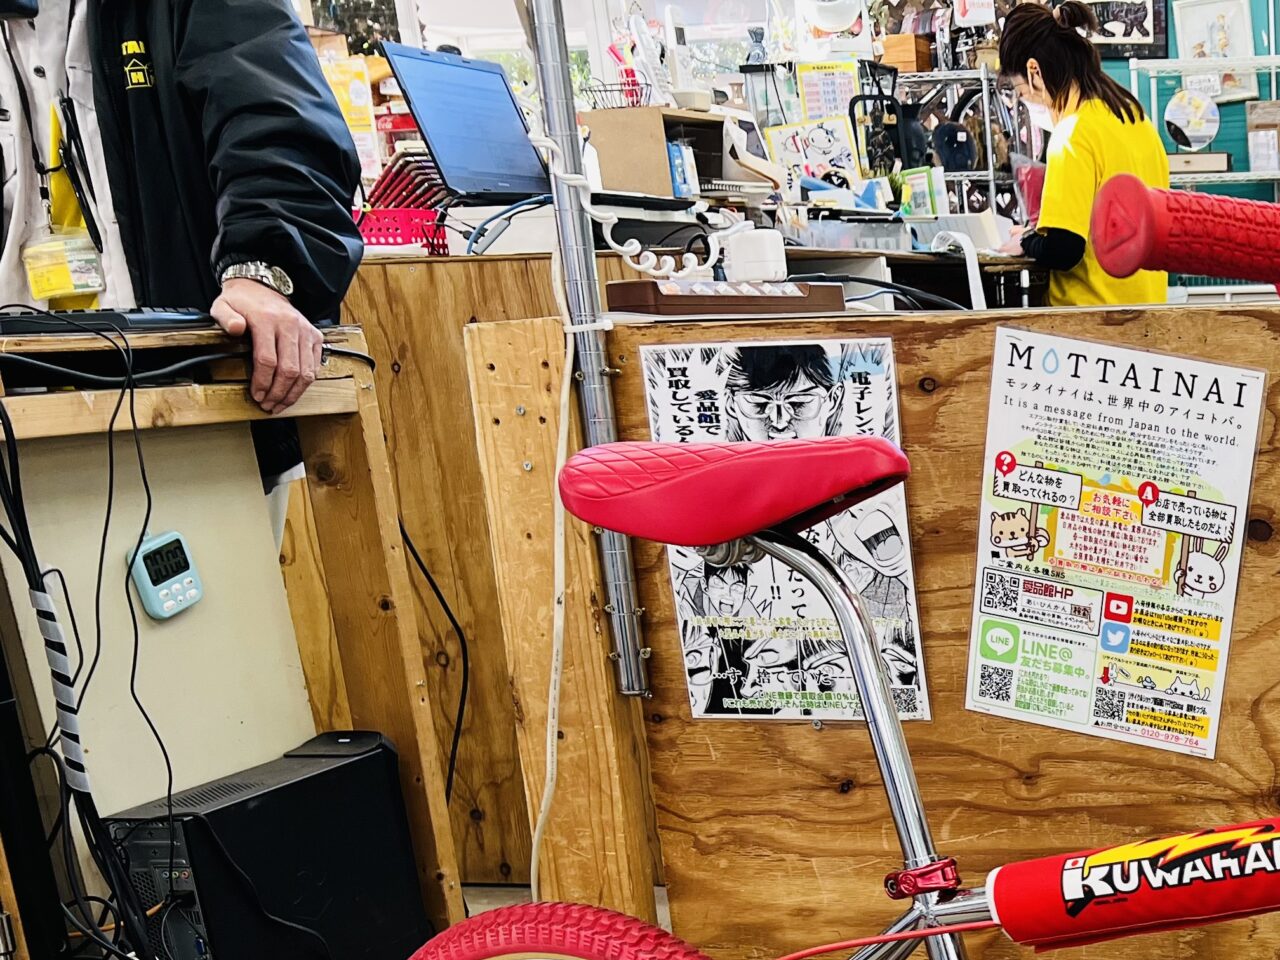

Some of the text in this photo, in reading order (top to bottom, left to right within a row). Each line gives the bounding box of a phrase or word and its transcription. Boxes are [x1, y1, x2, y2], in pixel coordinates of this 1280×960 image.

[694, 389, 721, 436] 愛品館で
[1006, 377, 1243, 430] モッタイナイは、世界中のアイコトバ。
[1003, 395, 1240, 448] It is a message from Japan to the world.
[1018, 470, 1063, 489] どんな物を
[1003, 481, 1076, 506] 買取ってくれるの？
[1093, 493, 1131, 508] お気軽に
[1083, 503, 1138, 520] ご相談下さい
[1155, 498, 1227, 521] お店で売っている物は
[1148, 511, 1228, 536] 全部買取したものだよ！
[1022, 579, 1074, 600] 愛品館HP
[1025, 598, 1068, 613] あいひんかん
[990, 634, 1010, 646] LINE
[1021, 639, 1073, 662] LINE@
[1020, 655, 1090, 680] 友だち募集中。
